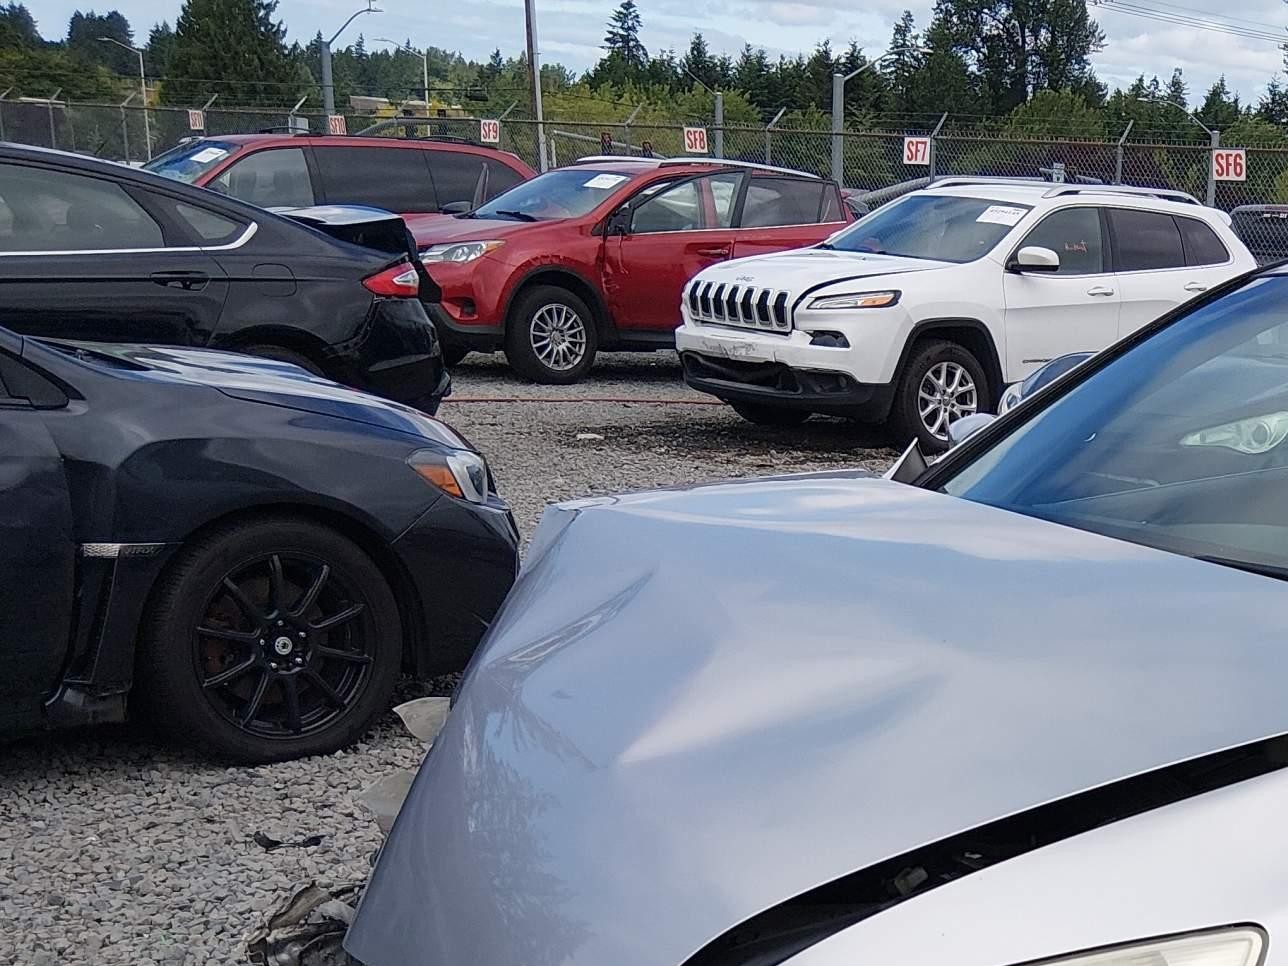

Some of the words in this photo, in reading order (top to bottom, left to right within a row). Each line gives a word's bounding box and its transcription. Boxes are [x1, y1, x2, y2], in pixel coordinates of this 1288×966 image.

[330, 117, 346, 134] SF10
[482, 122, 498, 140] SF9
[686, 130, 706, 150] SF8
[907, 140, 928, 162] SF7
[1215, 153, 1243, 177] SF6
